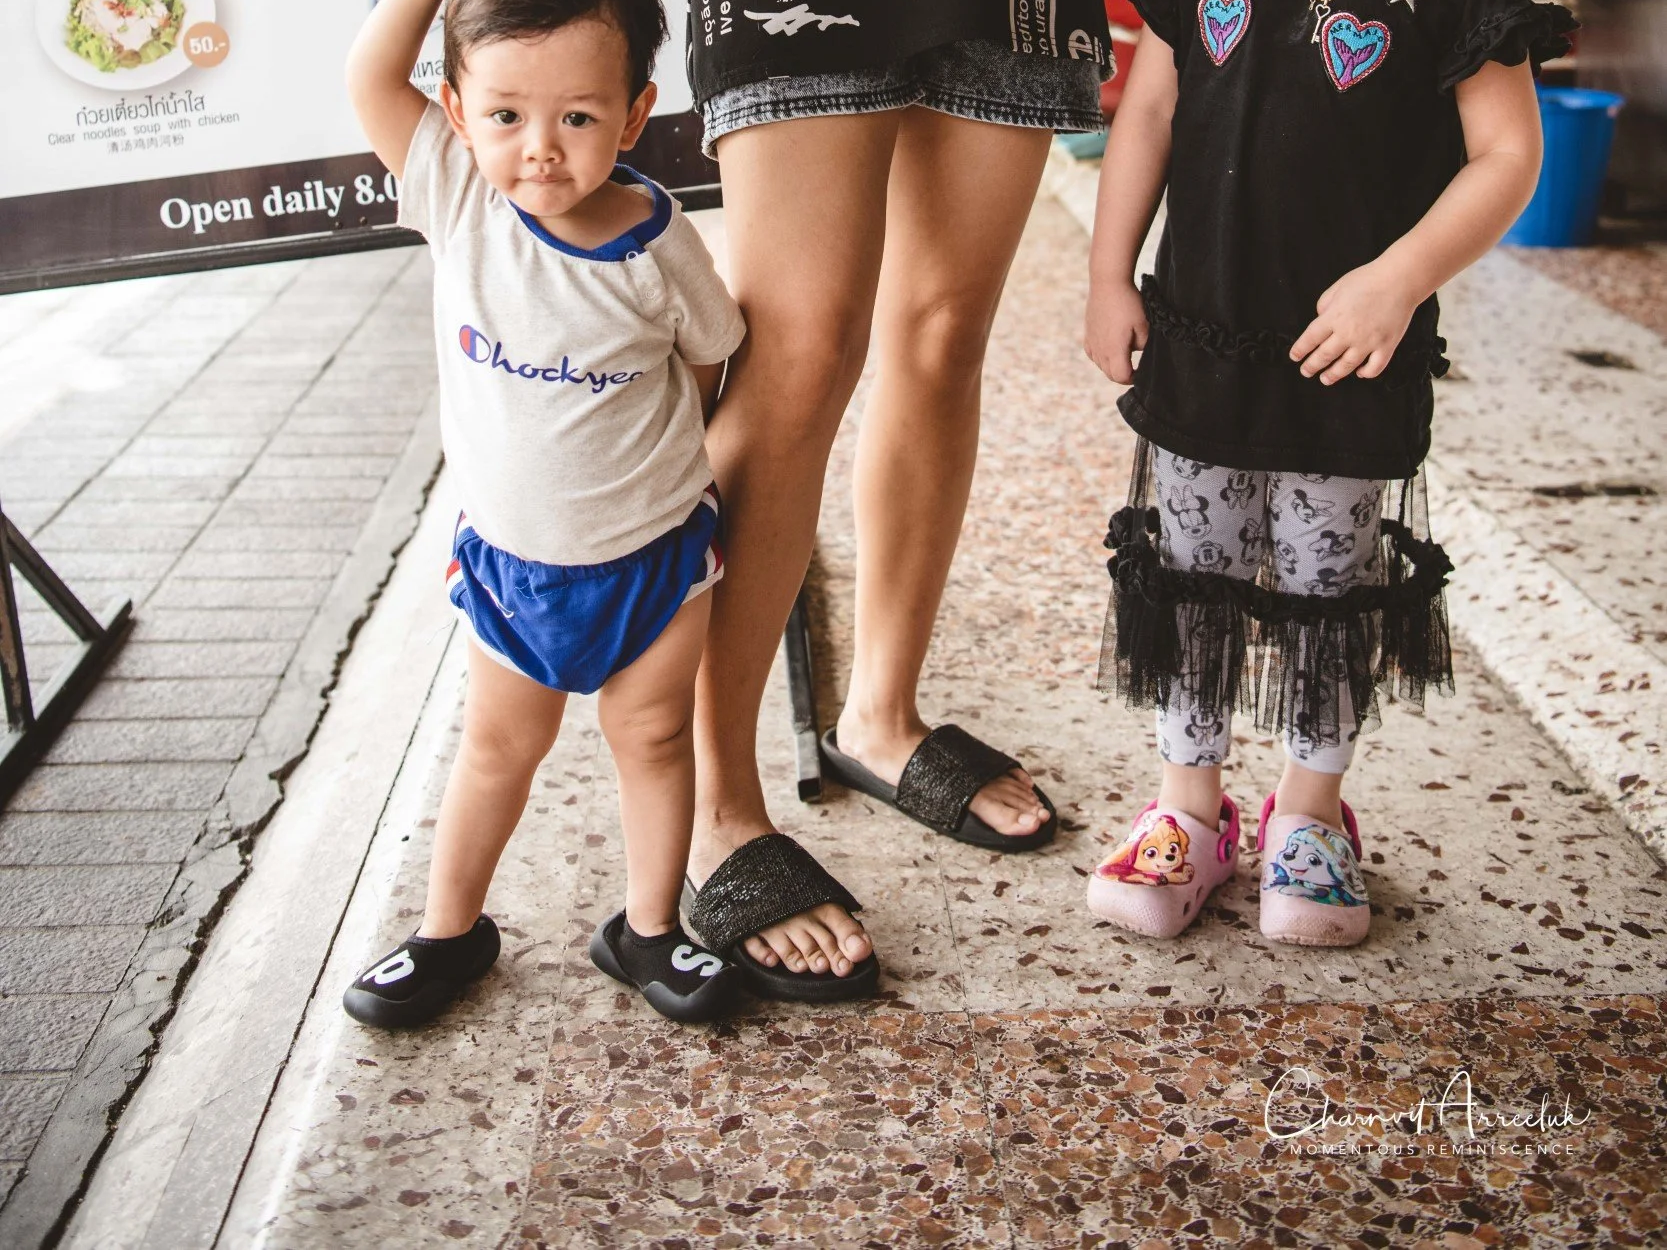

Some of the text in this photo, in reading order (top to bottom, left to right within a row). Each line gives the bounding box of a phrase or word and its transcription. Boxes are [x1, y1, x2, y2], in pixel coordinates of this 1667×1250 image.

[189, 36, 226, 55] 50.-
[48, 111, 240, 146] Clear noodles soup with chicken
[159, 197, 255, 235] Open
[262, 180, 345, 217] daily
